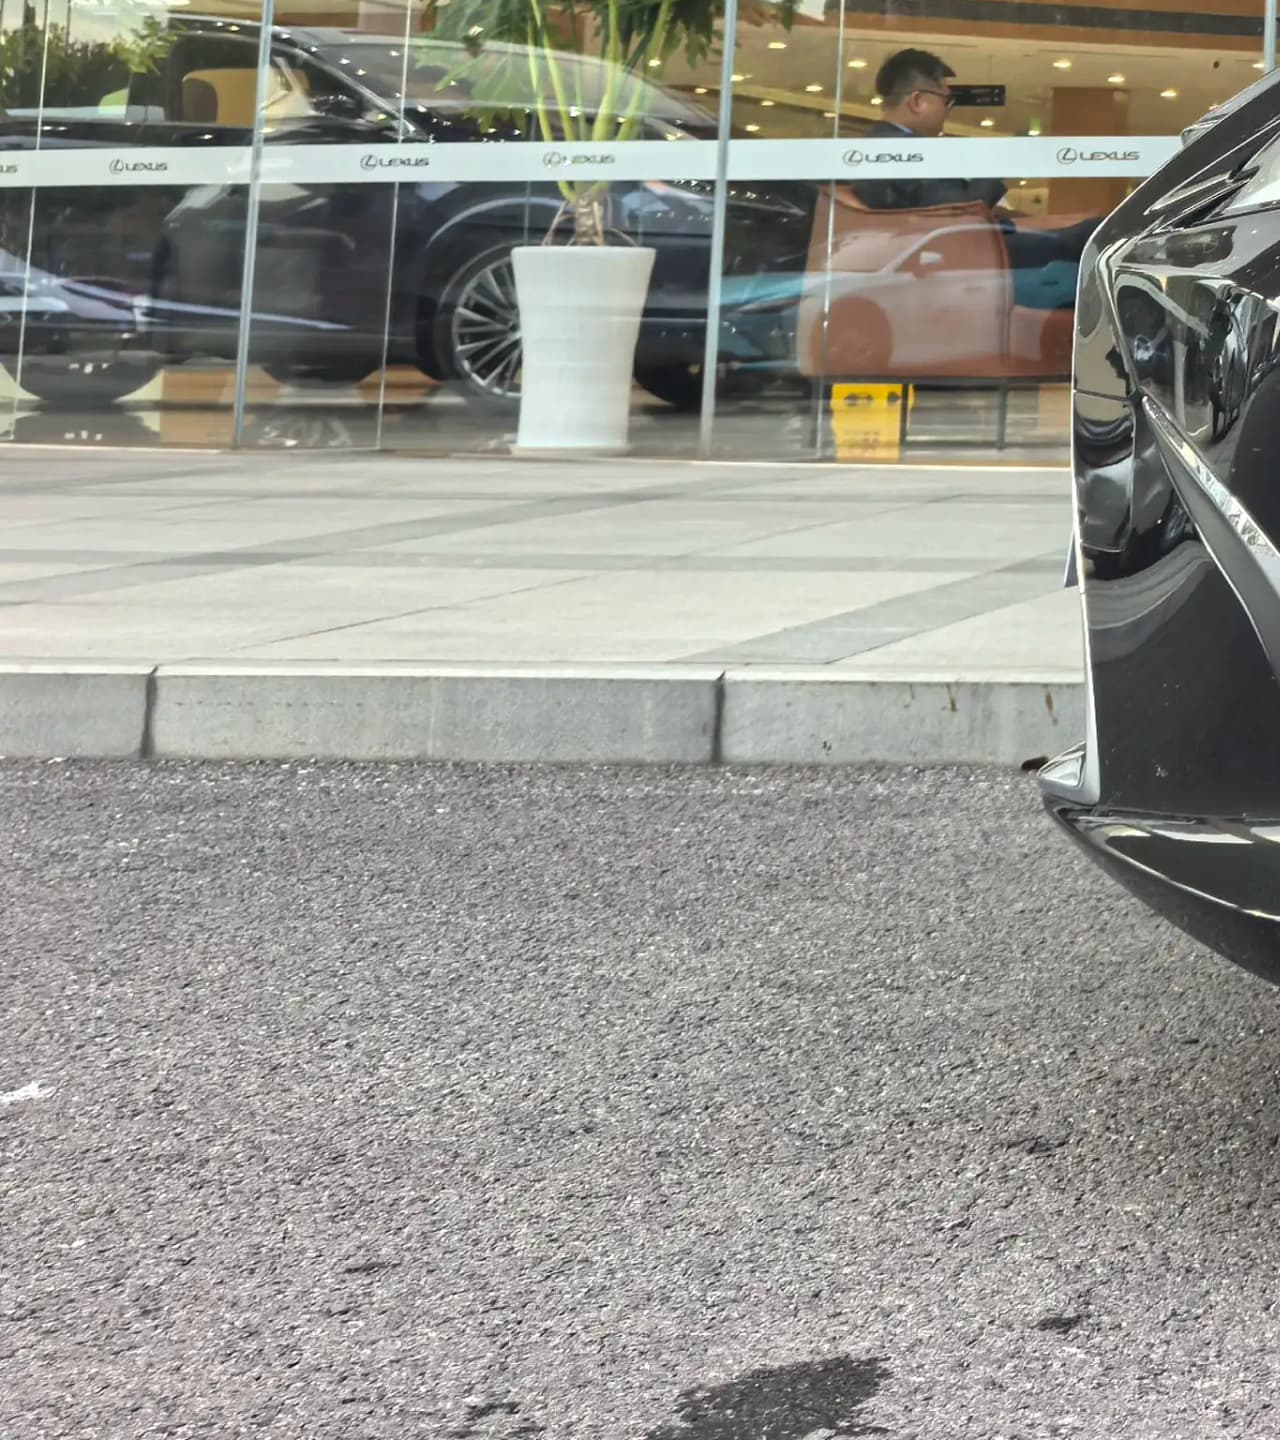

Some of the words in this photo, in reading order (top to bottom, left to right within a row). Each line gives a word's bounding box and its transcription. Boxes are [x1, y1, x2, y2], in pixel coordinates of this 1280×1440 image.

[864, 152, 924, 163] LEXUS
[1078, 151, 1141, 161] LEXUS
[125, 161, 168, 172] LEXUS
[378, 157, 430, 167] LEXUS
